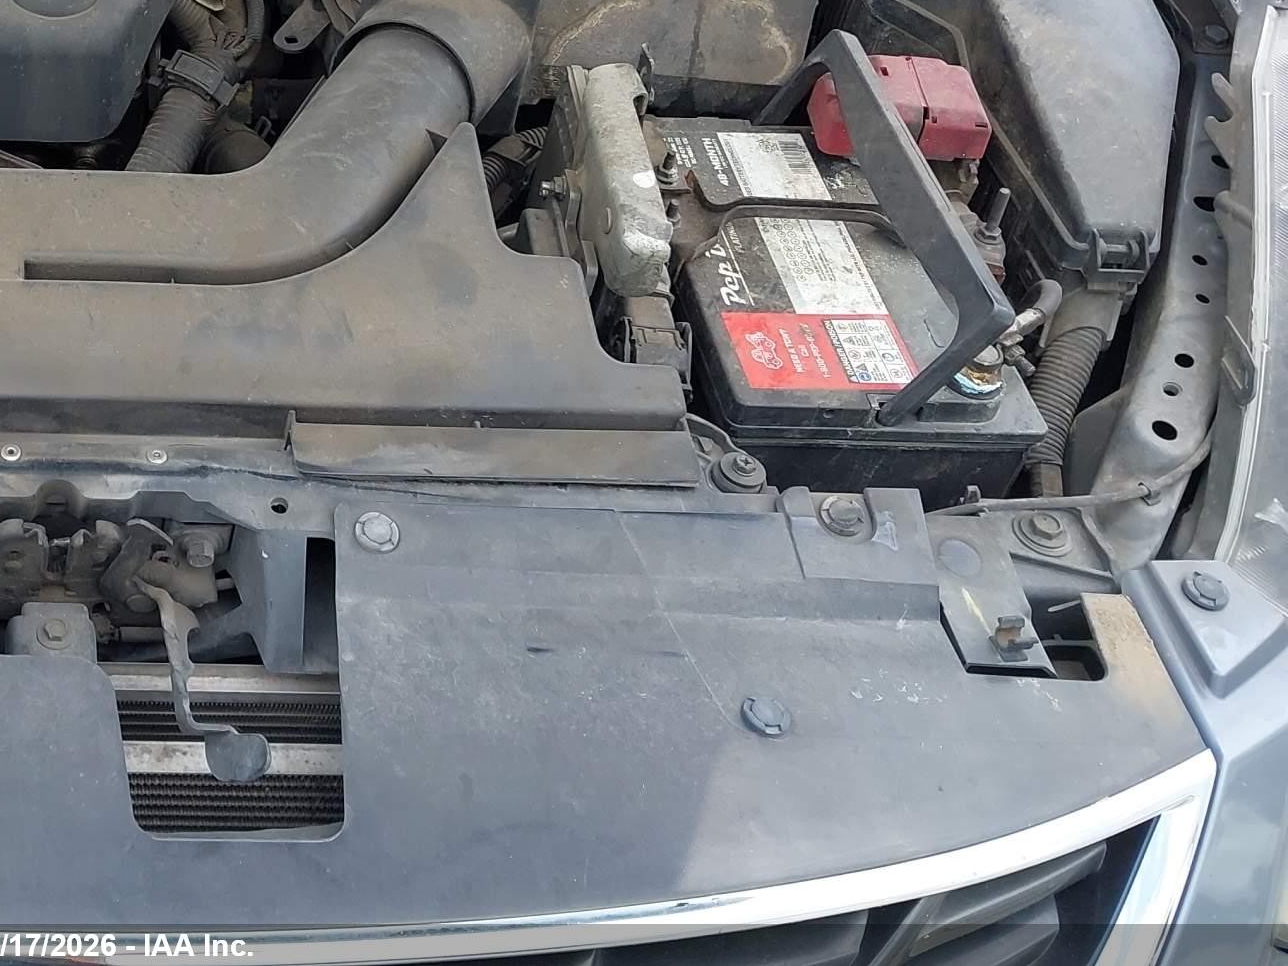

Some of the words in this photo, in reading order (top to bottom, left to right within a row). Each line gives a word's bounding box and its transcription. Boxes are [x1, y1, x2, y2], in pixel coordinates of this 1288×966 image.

[718, 261, 747, 305] Pep
[823, 320, 840, 344] POISON
[836, 348, 855, 375] DANGER
